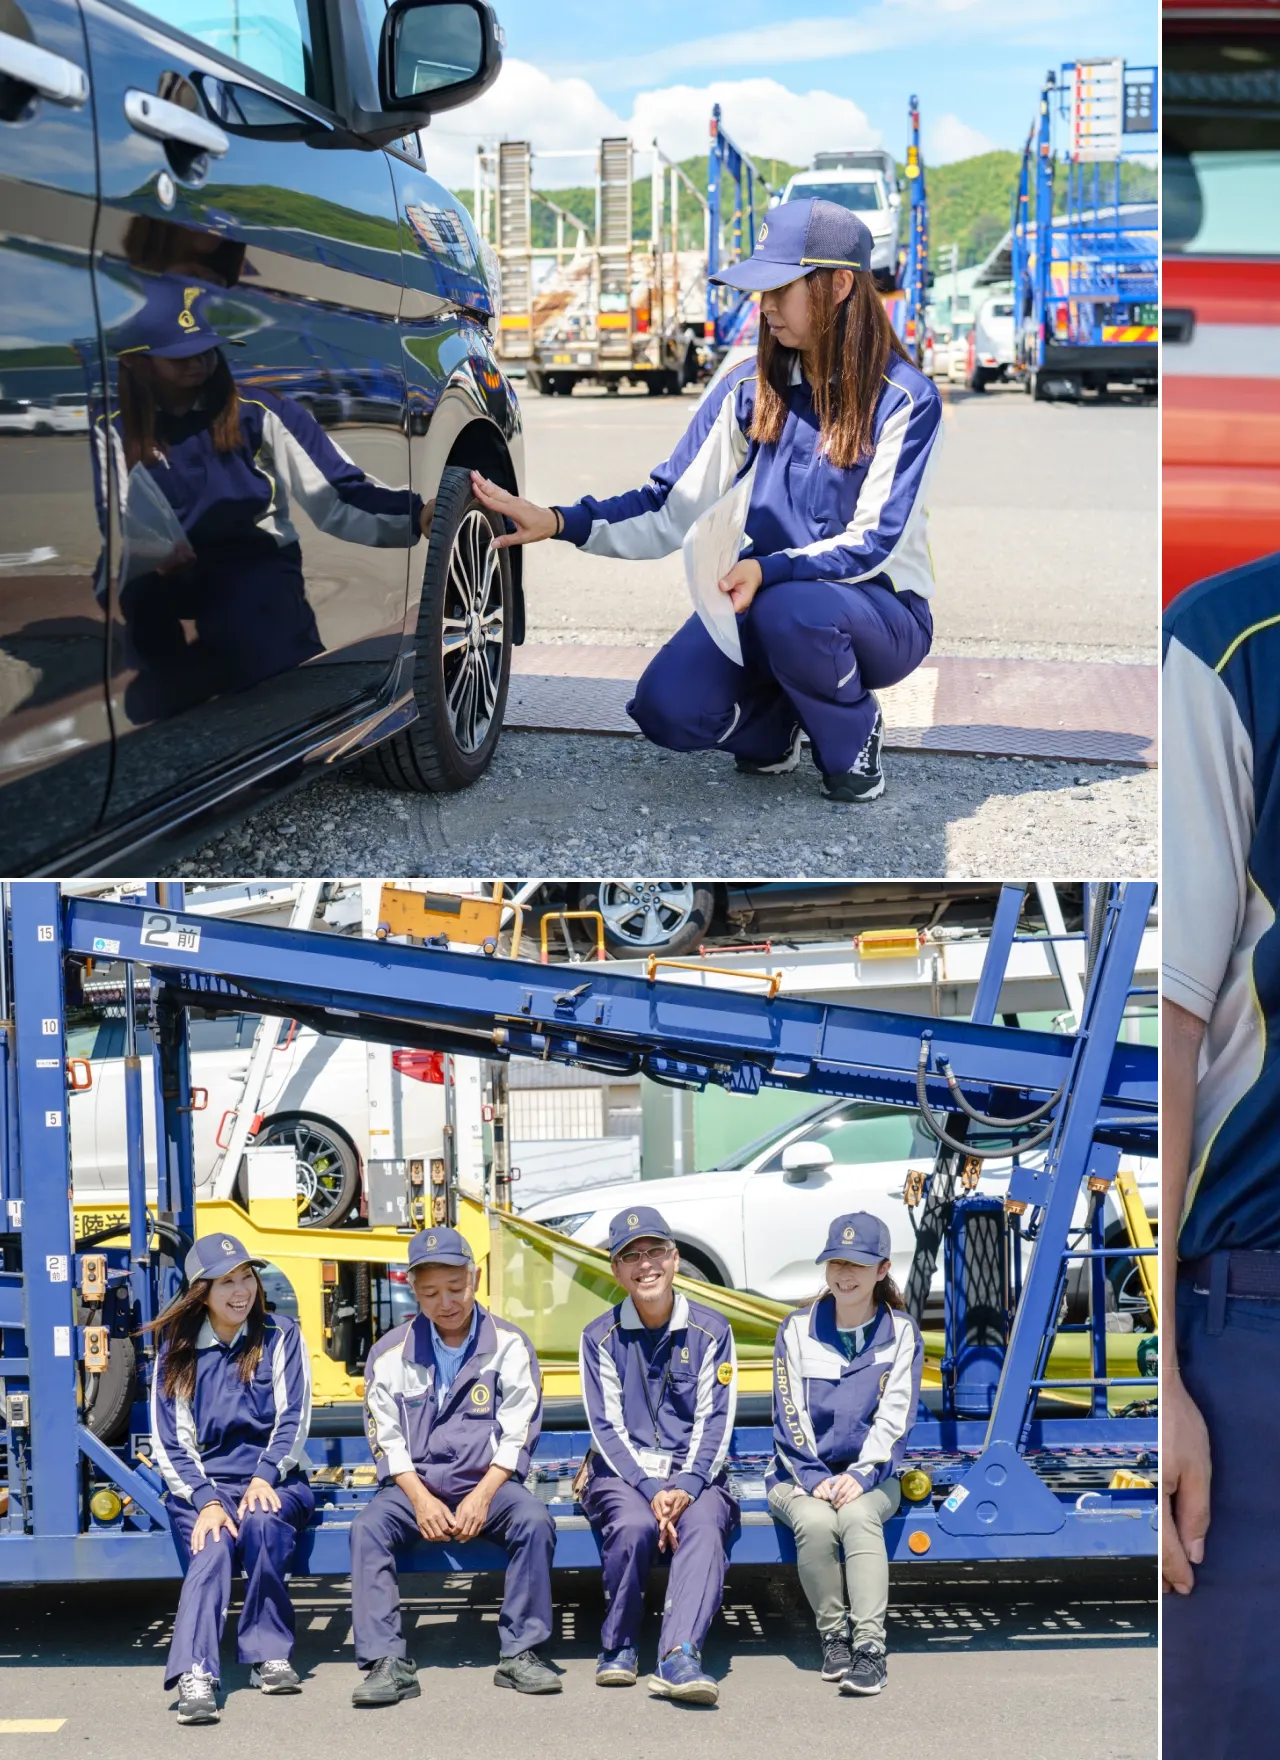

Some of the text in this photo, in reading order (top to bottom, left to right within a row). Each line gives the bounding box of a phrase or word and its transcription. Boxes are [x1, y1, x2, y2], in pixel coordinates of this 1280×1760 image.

[39, 927, 52, 940] 15
[43, 1020, 57, 1033] 10
[50, 1113, 57, 1125] 5
[776, 1357, 789, 1395] ZERO
